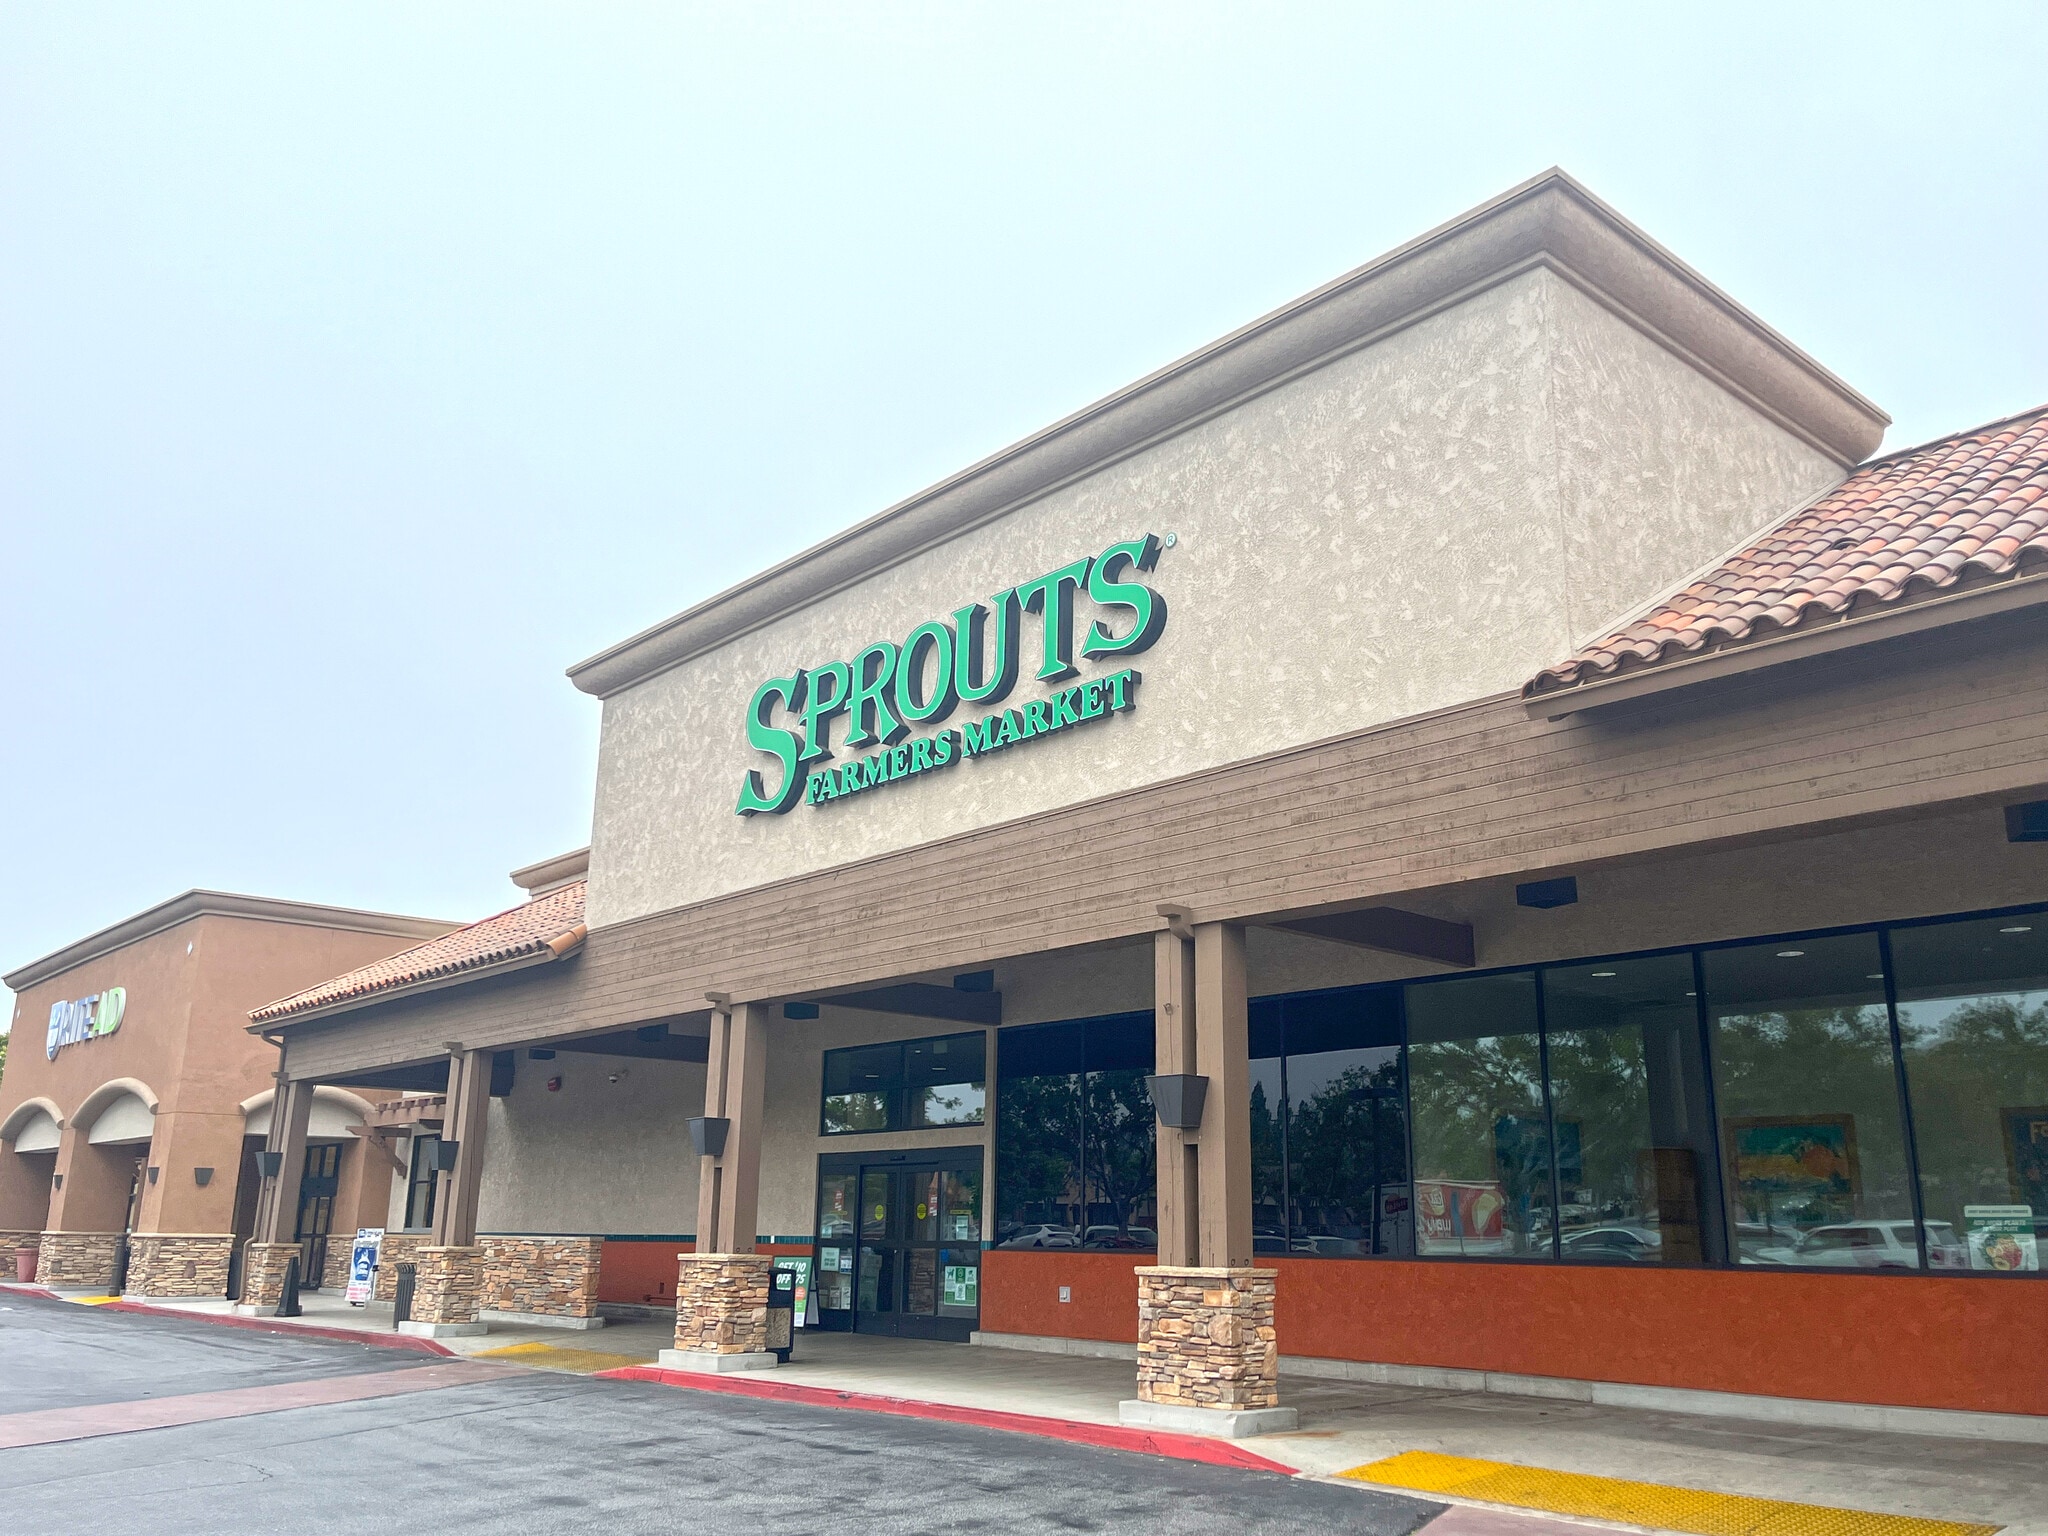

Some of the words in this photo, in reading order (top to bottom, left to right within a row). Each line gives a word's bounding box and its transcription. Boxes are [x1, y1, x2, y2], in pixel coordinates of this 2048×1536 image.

[735, 532, 1160, 816] SPROUTS
[805, 729, 958, 805] FARMERS
[961, 669, 1137, 759] MARKET
[776, 1273, 792, 1284] OFF
